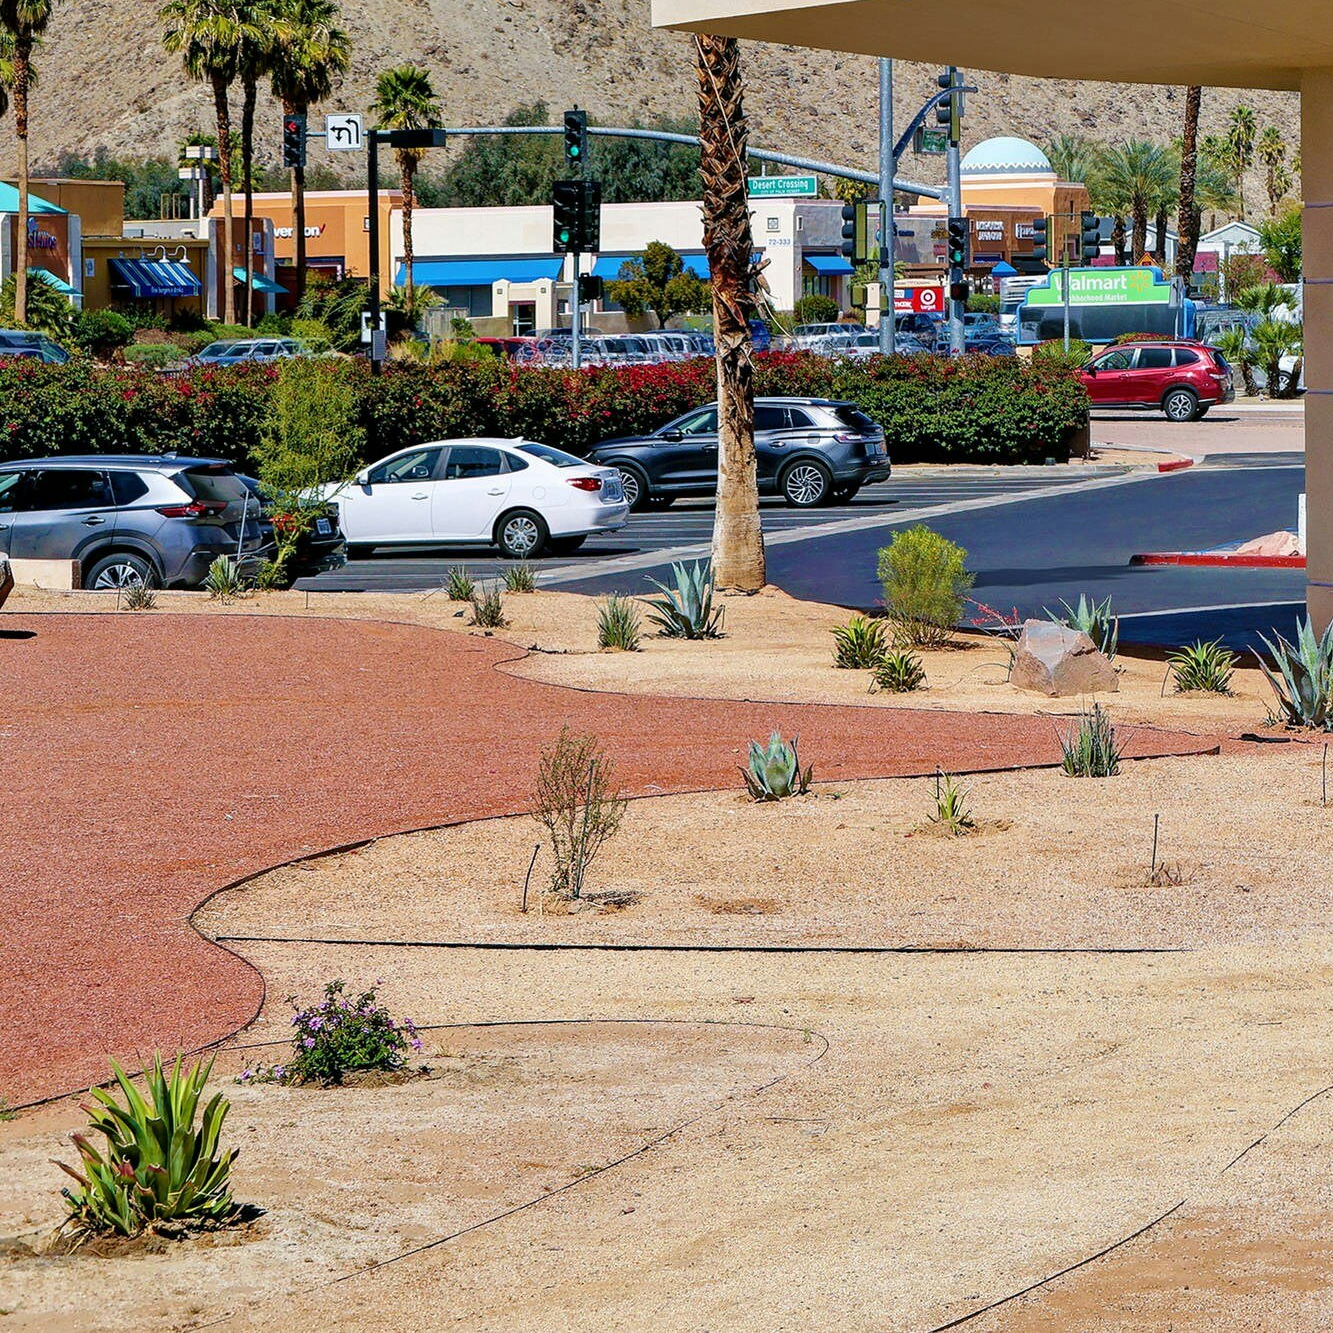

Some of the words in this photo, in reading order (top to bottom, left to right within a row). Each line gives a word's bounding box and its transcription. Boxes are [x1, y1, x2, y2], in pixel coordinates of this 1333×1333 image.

[752, 180, 776, 190] Desert
[777, 179, 809, 191] Crossing
[273, 226, 320, 238] veron
[1104, 293, 1128, 301] Market
